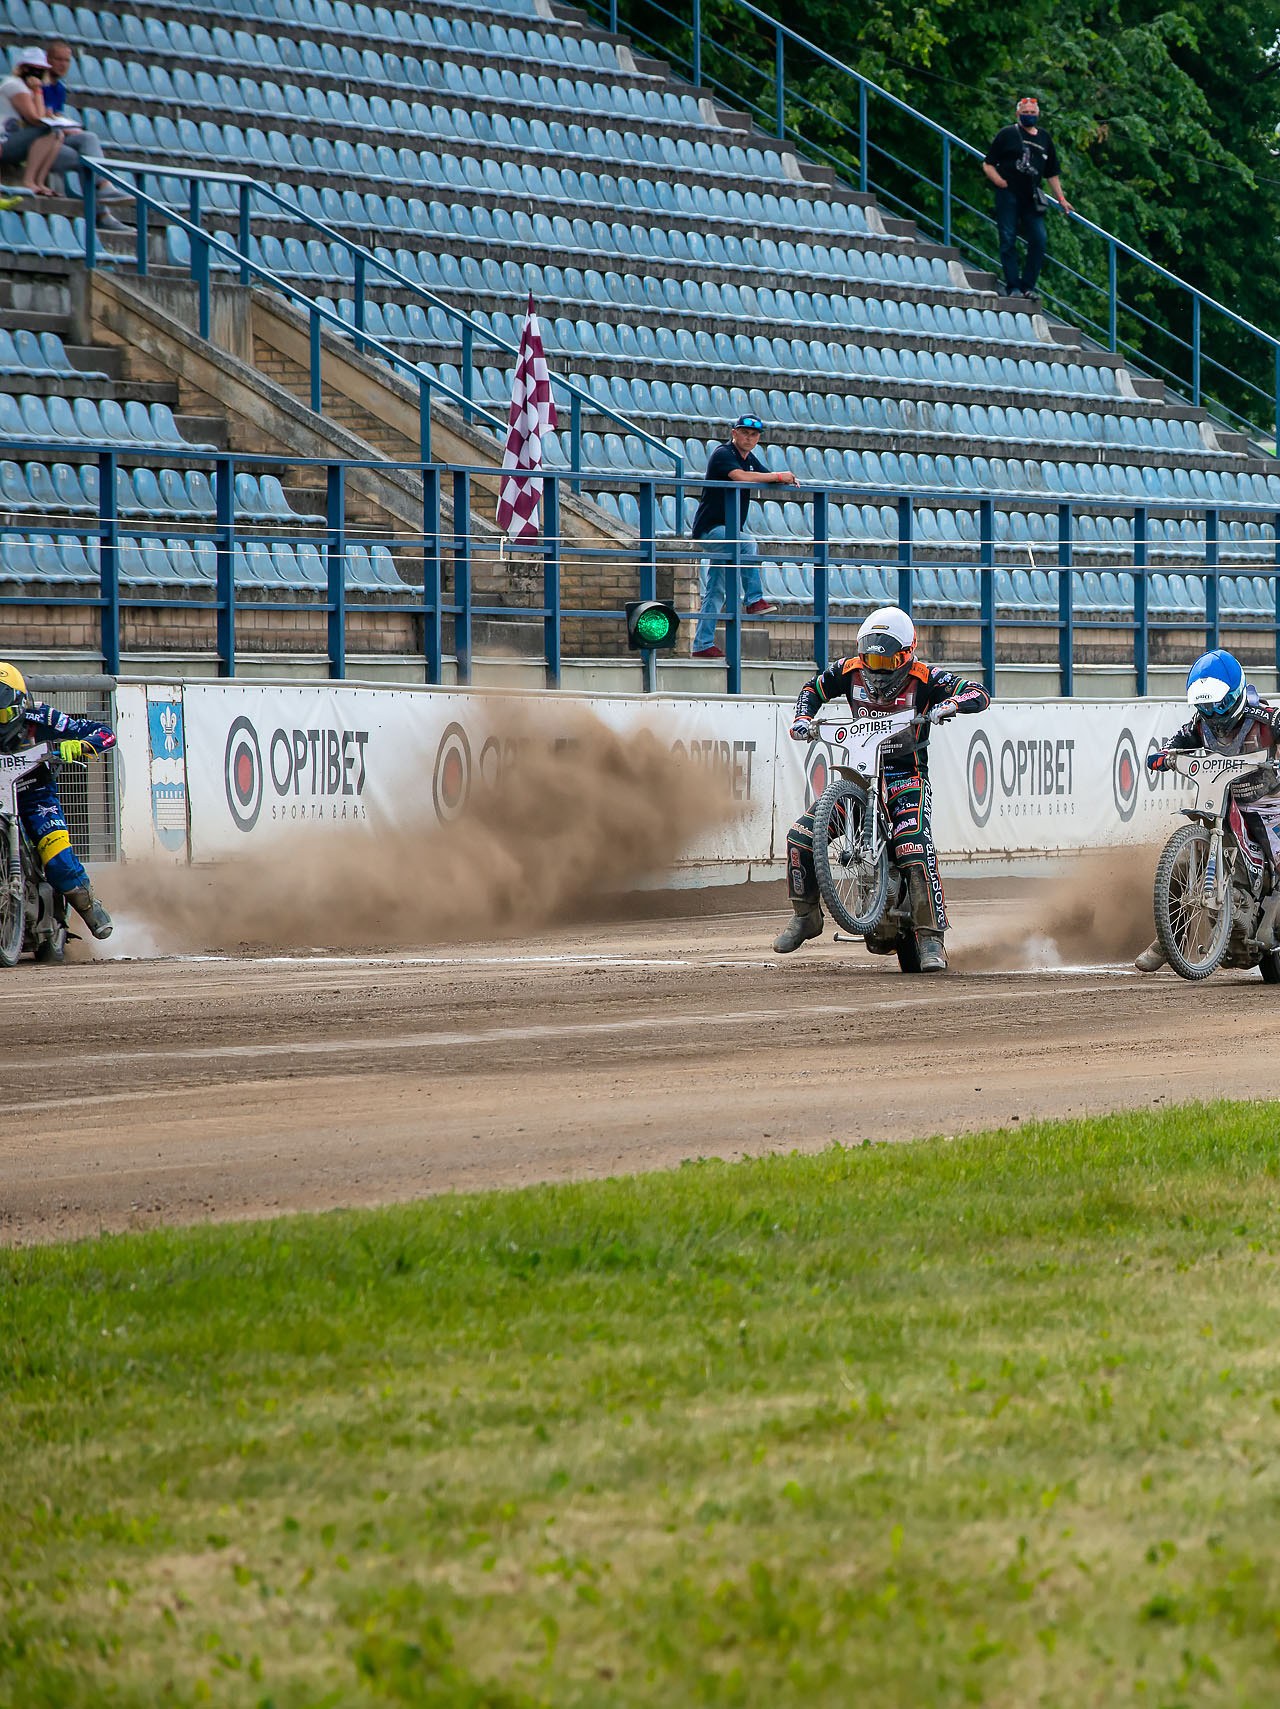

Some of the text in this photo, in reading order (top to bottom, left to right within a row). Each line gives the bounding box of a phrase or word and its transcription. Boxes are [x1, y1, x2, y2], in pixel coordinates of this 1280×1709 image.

[850, 720, 893, 735] OPTIBET
[270, 728, 369, 796] OPTIBET
[1001, 740, 1074, 797] OPTIBET
[1203, 759, 1245, 770] OPTIBET
[272, 805, 324, 820] SPORTA
[1000, 803, 1042, 817] SPORTA
